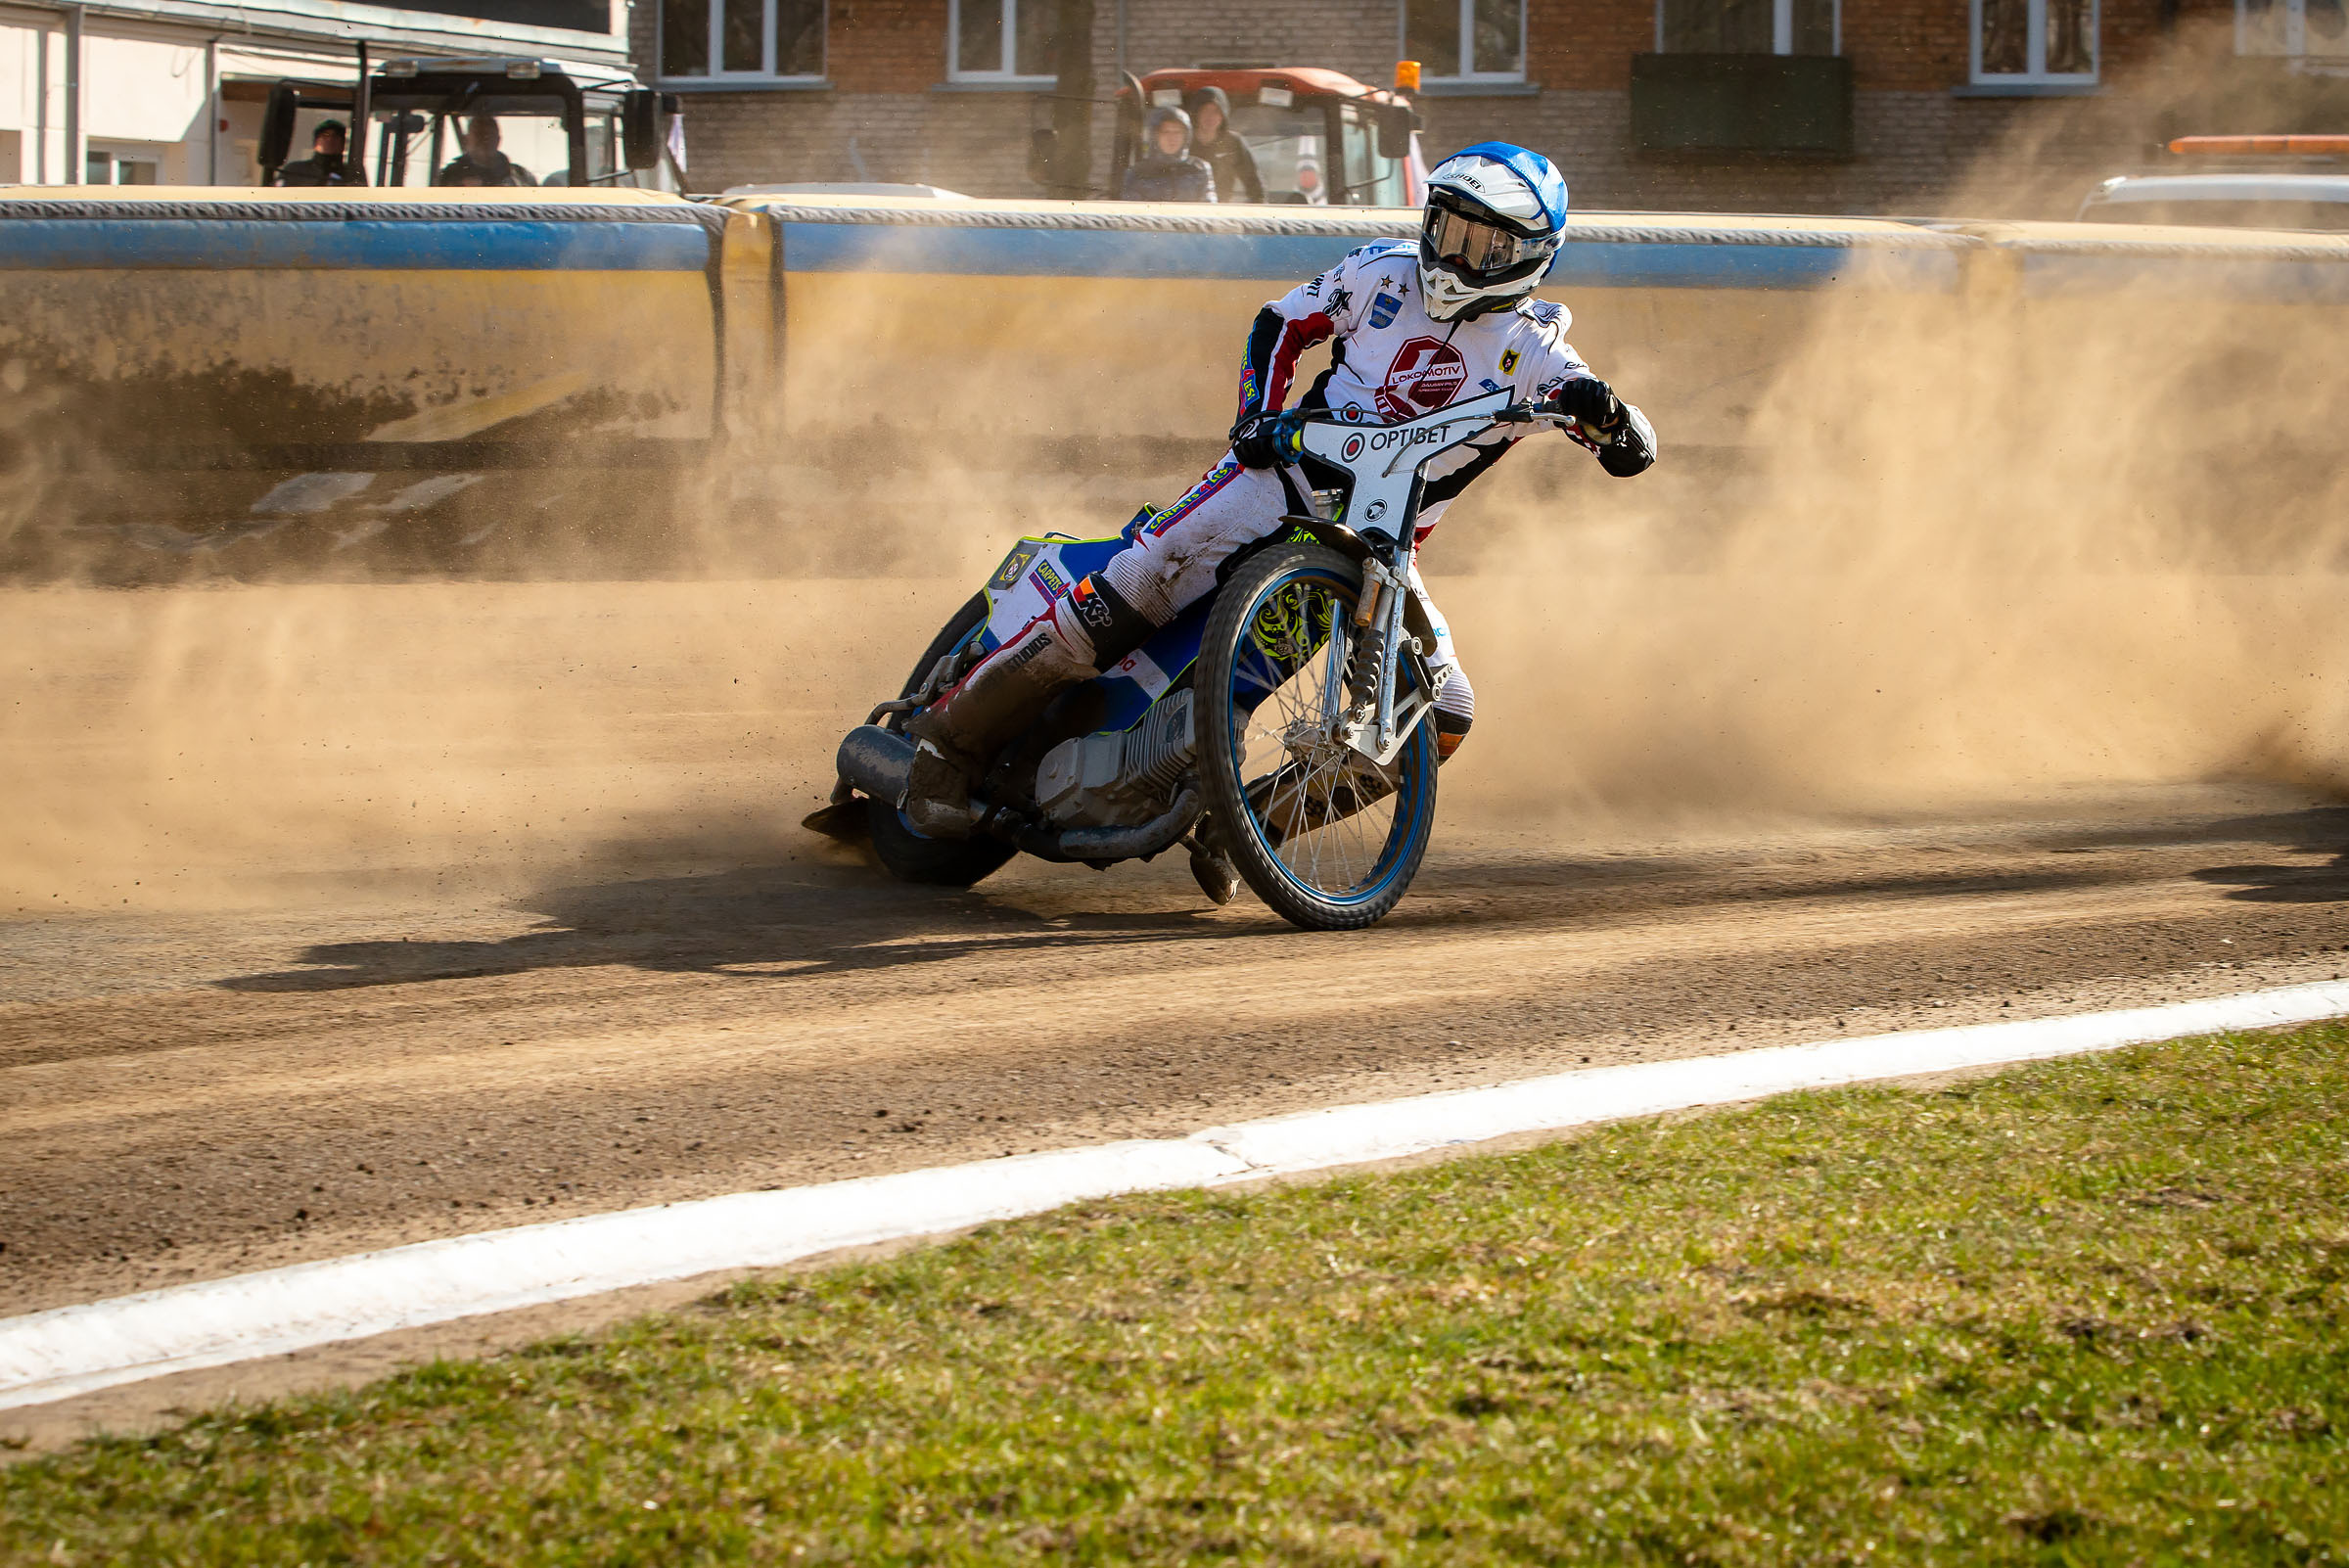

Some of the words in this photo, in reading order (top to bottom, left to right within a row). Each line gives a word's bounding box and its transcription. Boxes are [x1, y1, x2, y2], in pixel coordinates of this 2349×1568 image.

[1448, 173, 1482, 190] SHOEI
[1392, 366, 1460, 385] LOKOMOTIV
[1371, 425, 1451, 450] OPTIBET
[1150, 492, 1200, 530] CARPETS
[1037, 562, 1062, 591] CARPETS
